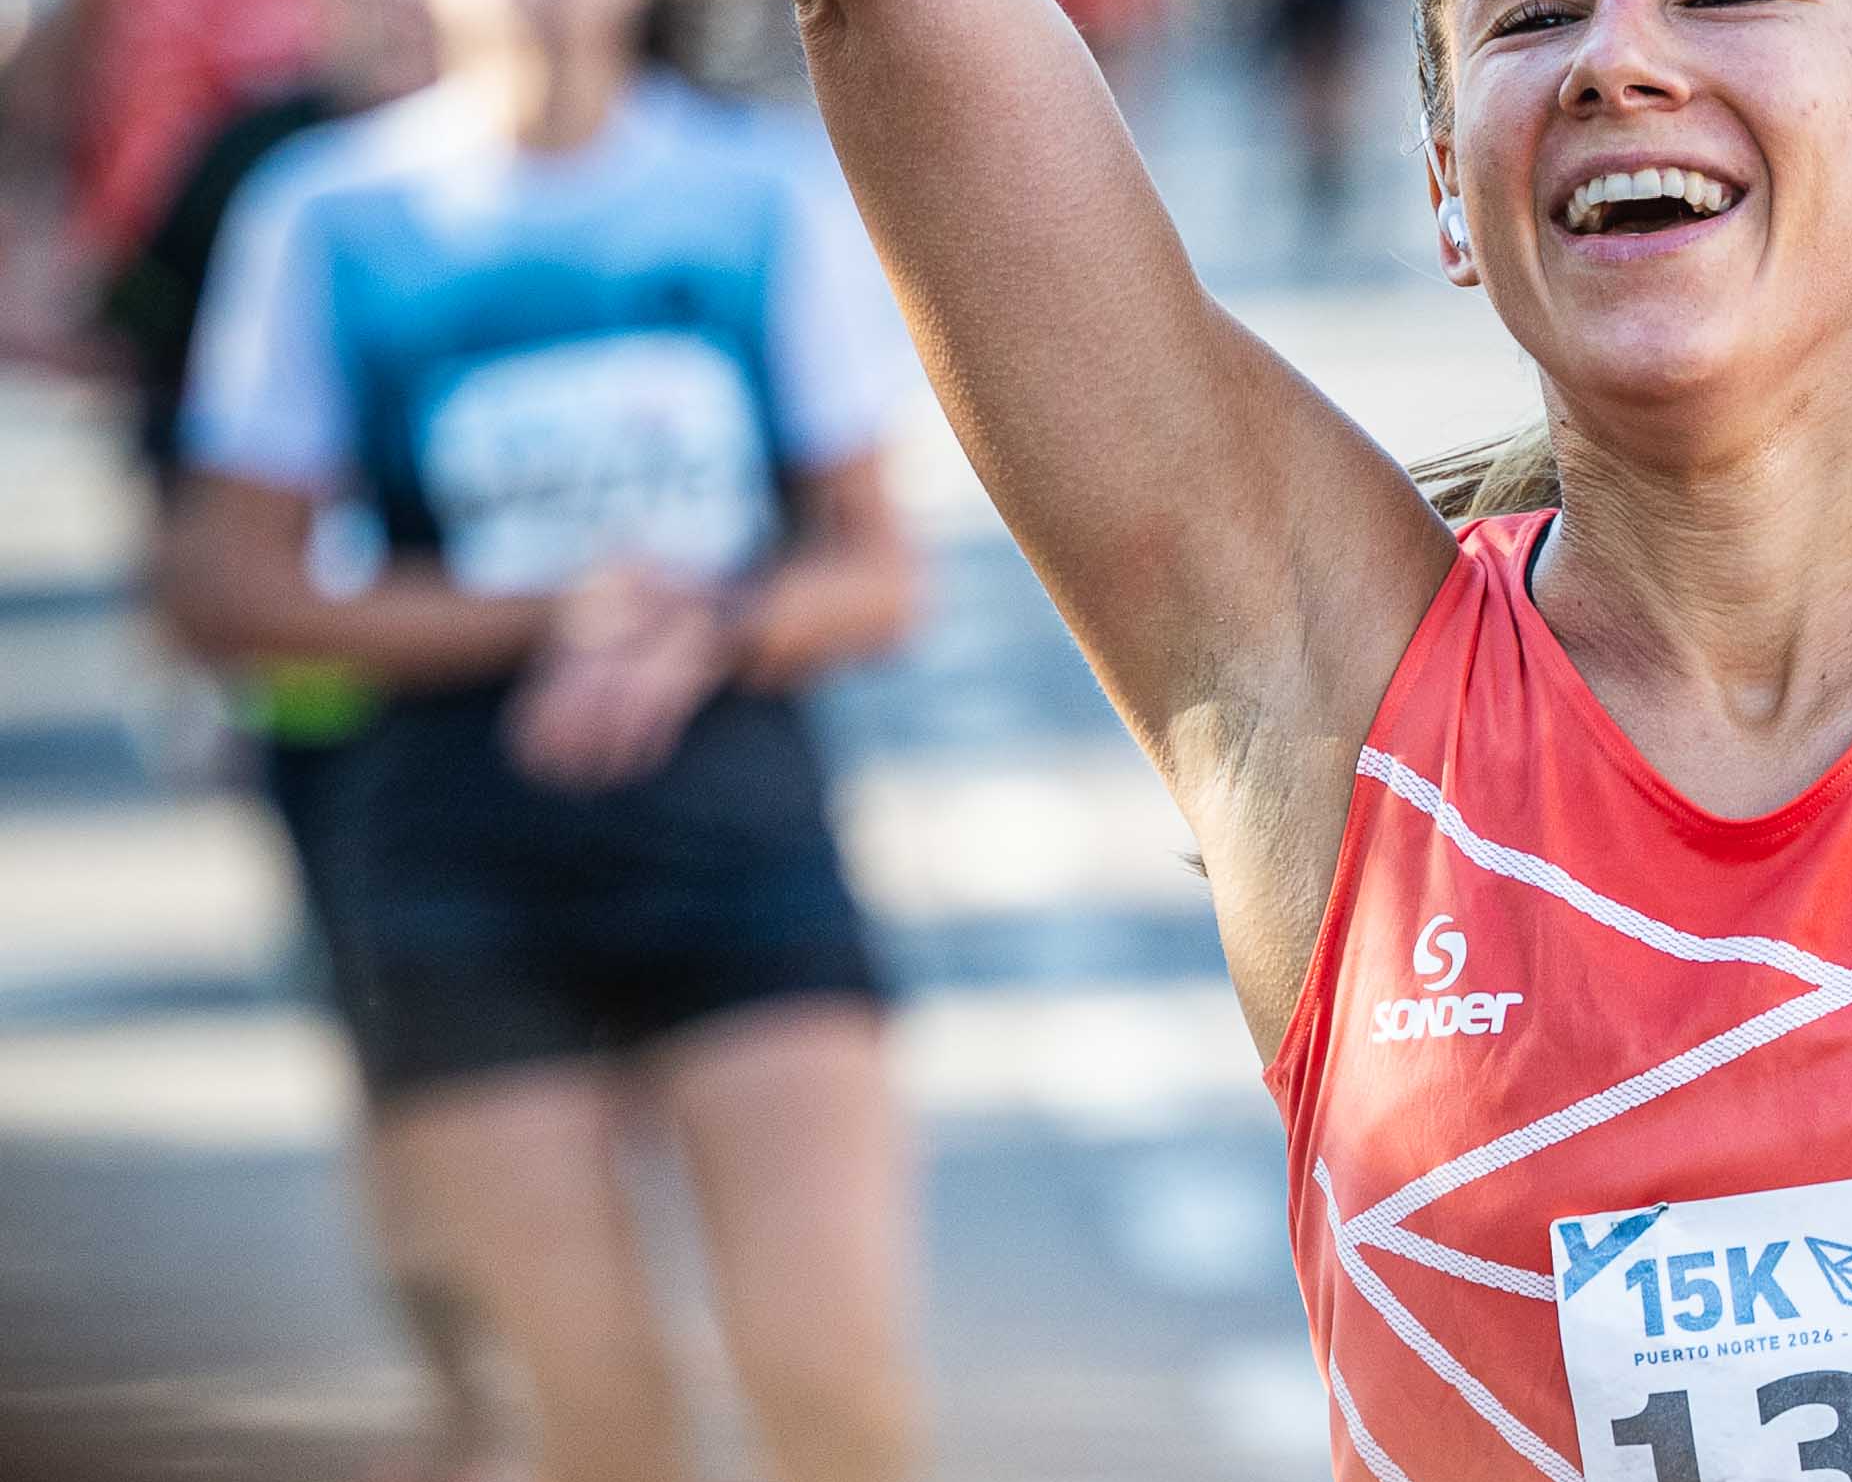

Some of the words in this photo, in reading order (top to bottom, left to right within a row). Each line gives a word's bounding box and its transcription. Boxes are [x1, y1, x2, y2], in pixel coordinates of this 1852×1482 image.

[1625, 1240, 1801, 1338] 15K
[1634, 1344, 1709, 1367] PUERTO
[1717, 1334, 1781, 1357] NORTE
[1788, 1328, 1833, 1348] 2026
